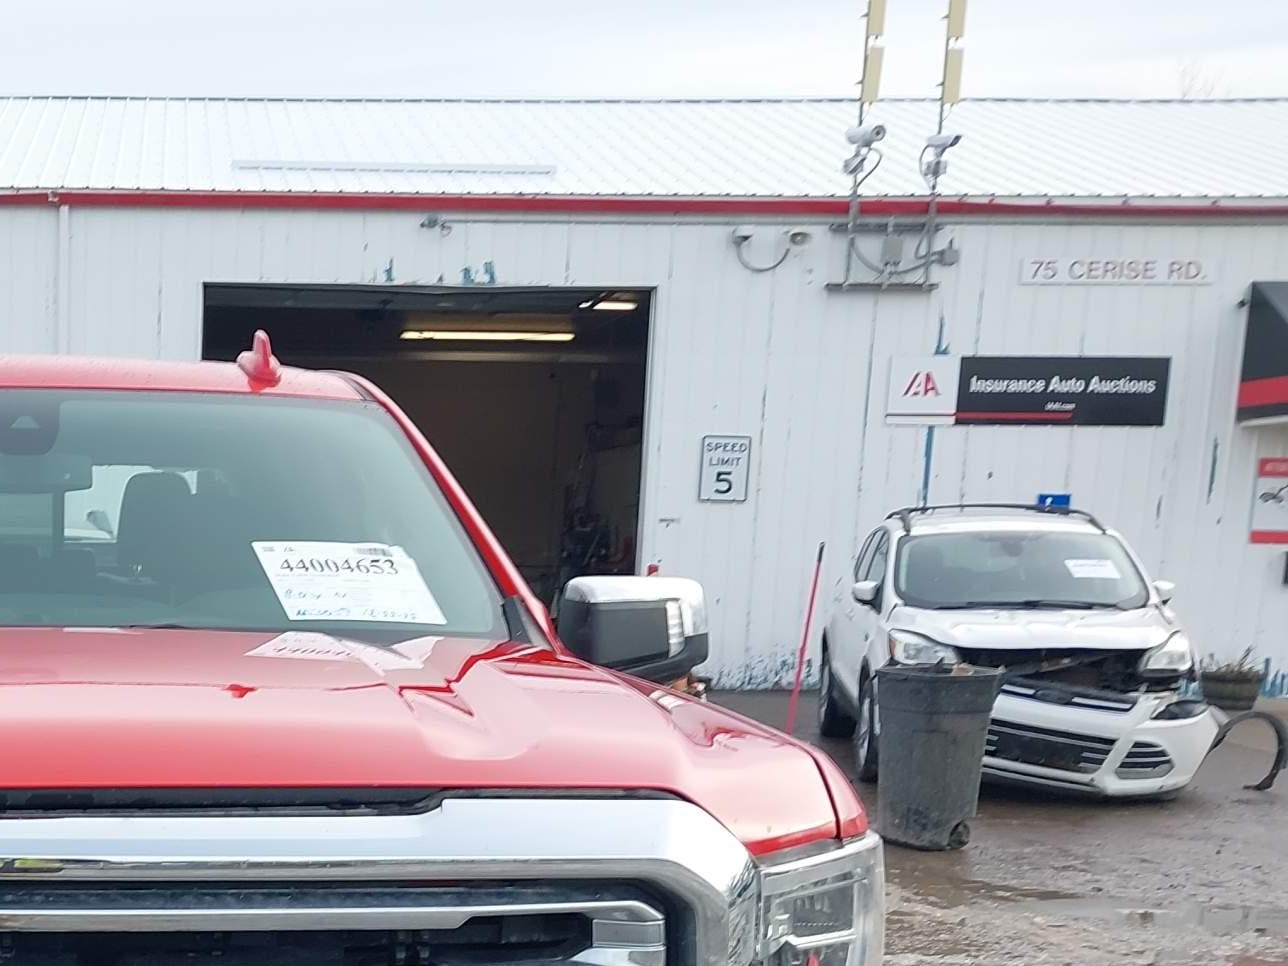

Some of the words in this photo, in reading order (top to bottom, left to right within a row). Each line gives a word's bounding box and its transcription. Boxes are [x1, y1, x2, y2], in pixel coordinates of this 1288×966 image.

[1030, 259, 1058, 280] 75
[1067, 259, 1158, 281] CERISE
[1167, 259, 1209, 281] RD.
[969, 375, 1045, 394] Insurance
[1048, 375, 1085, 394] Auto
[1087, 375, 1157, 395] Auctions
[707, 442, 747, 452] SPEED
[709, 457, 741, 466] LIMIT
[713, 470, 733, 494] 5
[280, 558, 399, 575] 44004653
